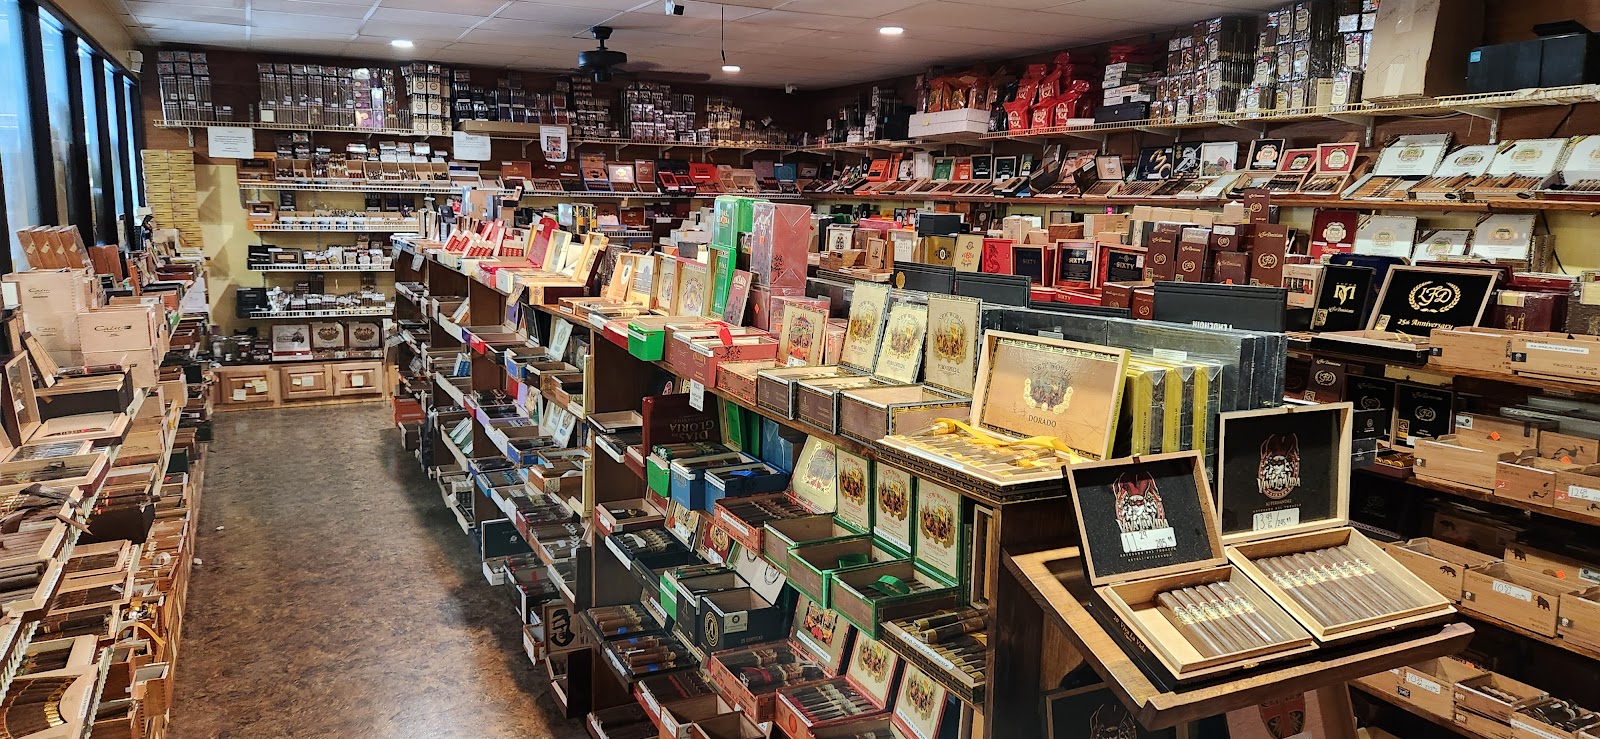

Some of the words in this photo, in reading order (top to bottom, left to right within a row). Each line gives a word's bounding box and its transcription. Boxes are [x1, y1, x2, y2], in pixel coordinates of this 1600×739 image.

[1116, 261, 1135, 270] SIXTY
[1411, 319, 1454, 330] Anniversary
[1050, 362, 1072, 380] WORLD
[670, 420, 715, 432] GLORIA
[1028, 414, 1057, 428] DORADO
[679, 430, 709, 440] DIAS
